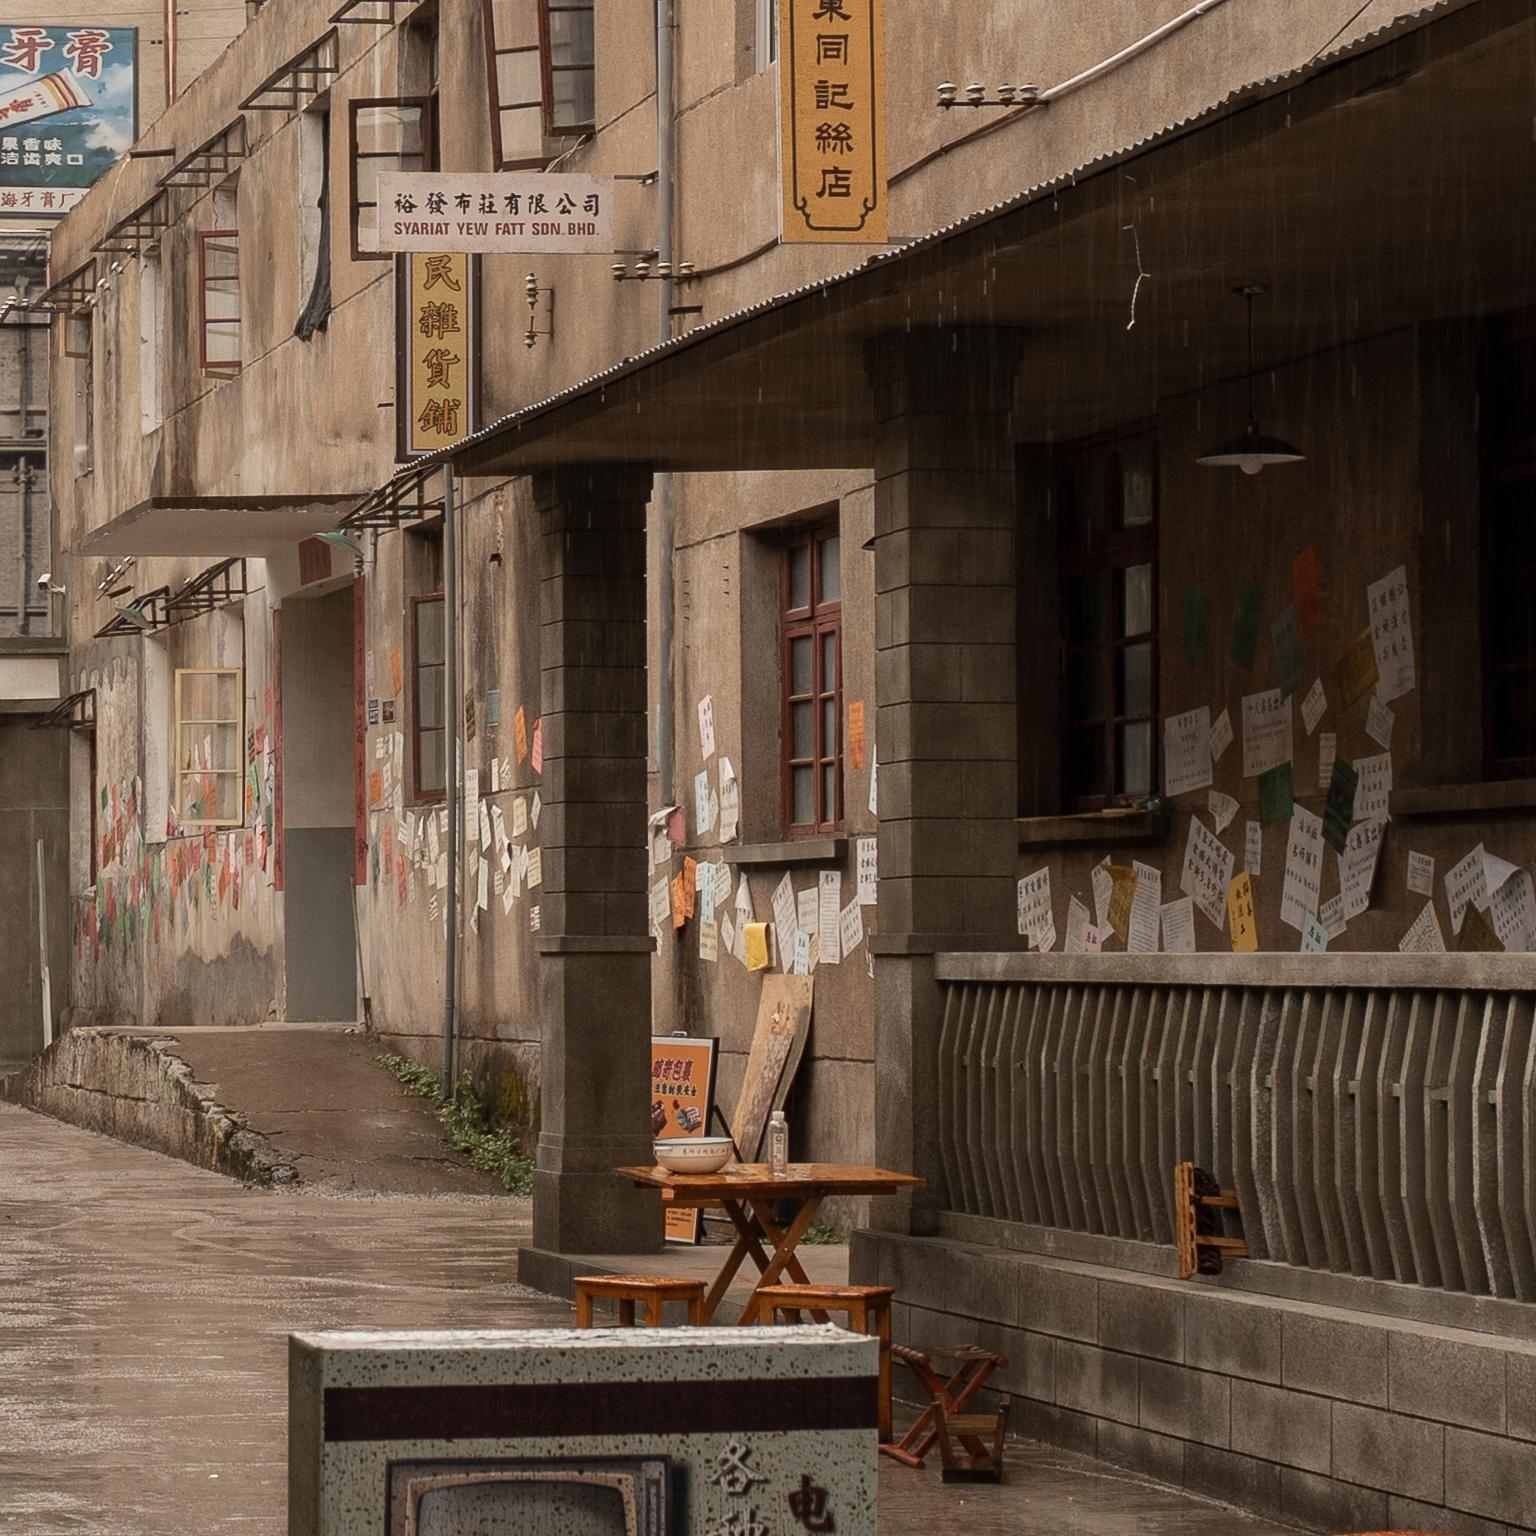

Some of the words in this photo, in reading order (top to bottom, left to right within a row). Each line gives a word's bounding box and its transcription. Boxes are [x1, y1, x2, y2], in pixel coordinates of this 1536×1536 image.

[0, 152, 85, 166] 洁齿爽口
[393, 192, 601, 218] 裕發布莊有限公司
[393, 222, 451, 237] SYARIAT
[456, 222, 489, 237] YEW
[494, 222, 525, 237] FATT
